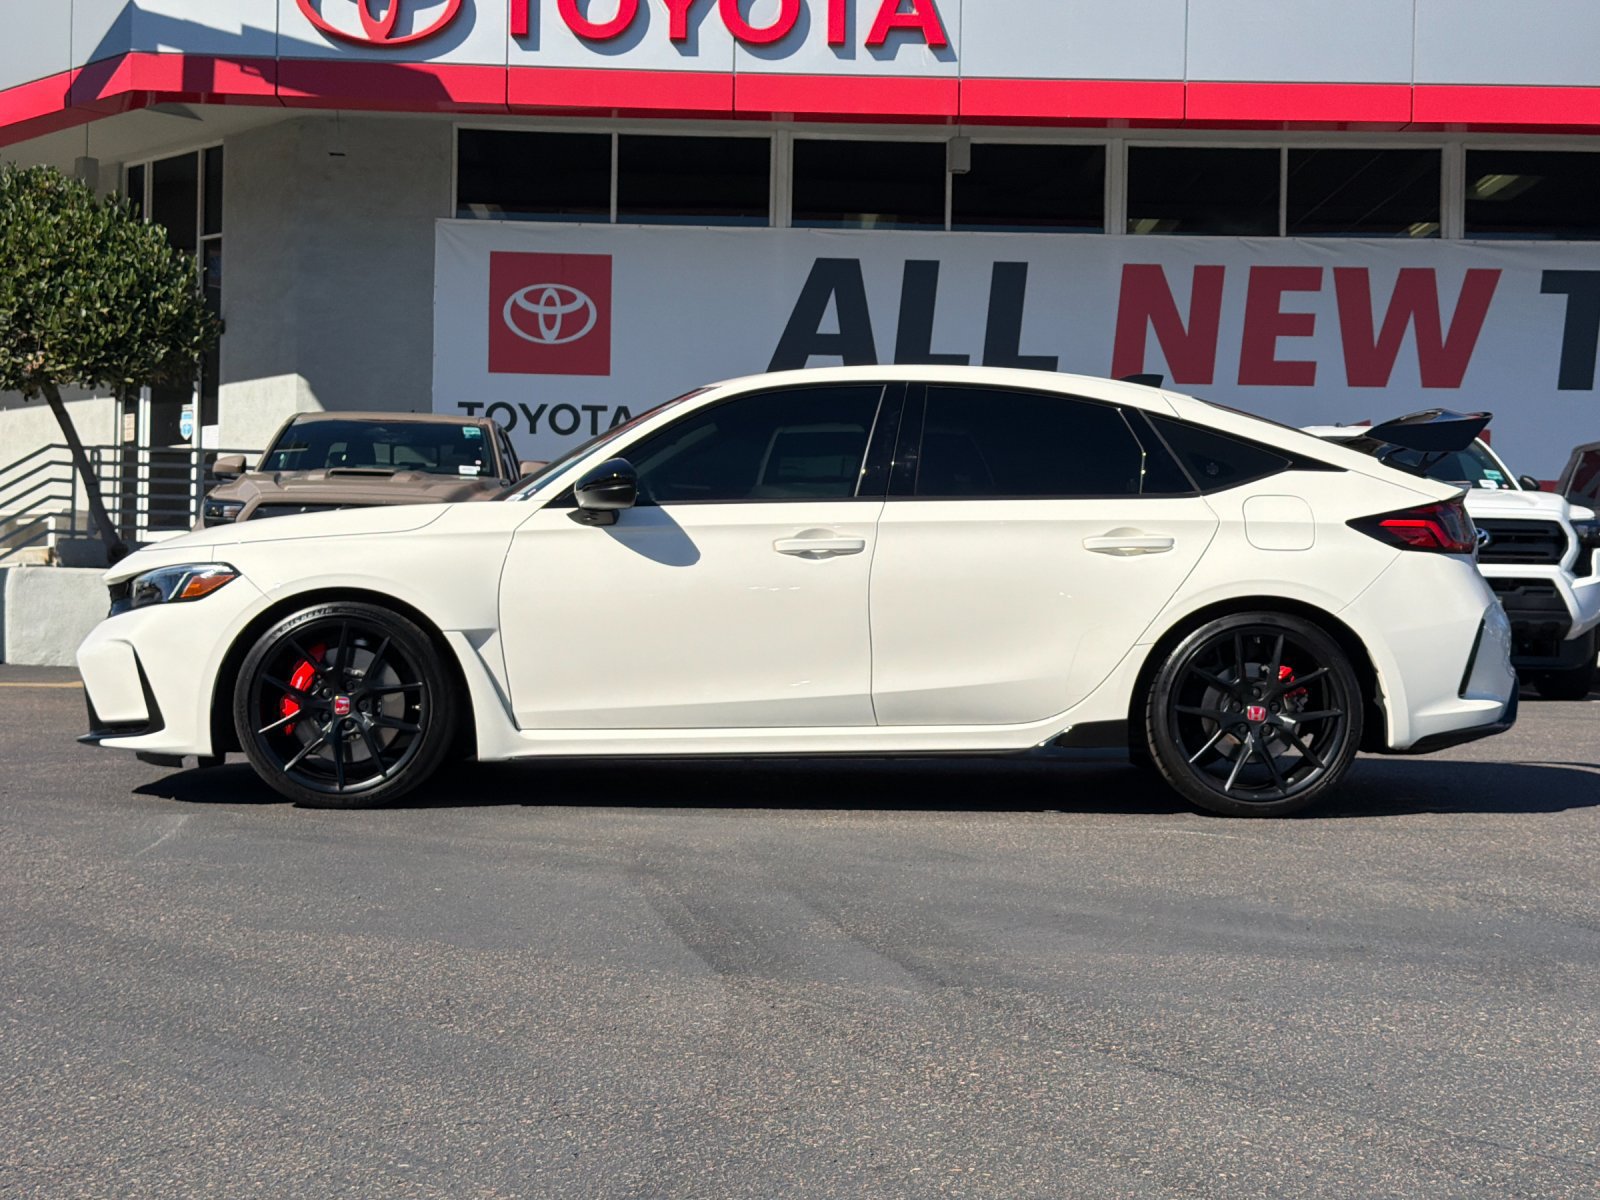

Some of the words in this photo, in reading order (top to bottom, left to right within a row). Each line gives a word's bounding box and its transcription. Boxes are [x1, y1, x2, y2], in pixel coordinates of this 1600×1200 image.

[766, 257, 1059, 373] ALL
[1111, 263, 1503, 388] NEW
[1540, 269, 1600, 391] T
